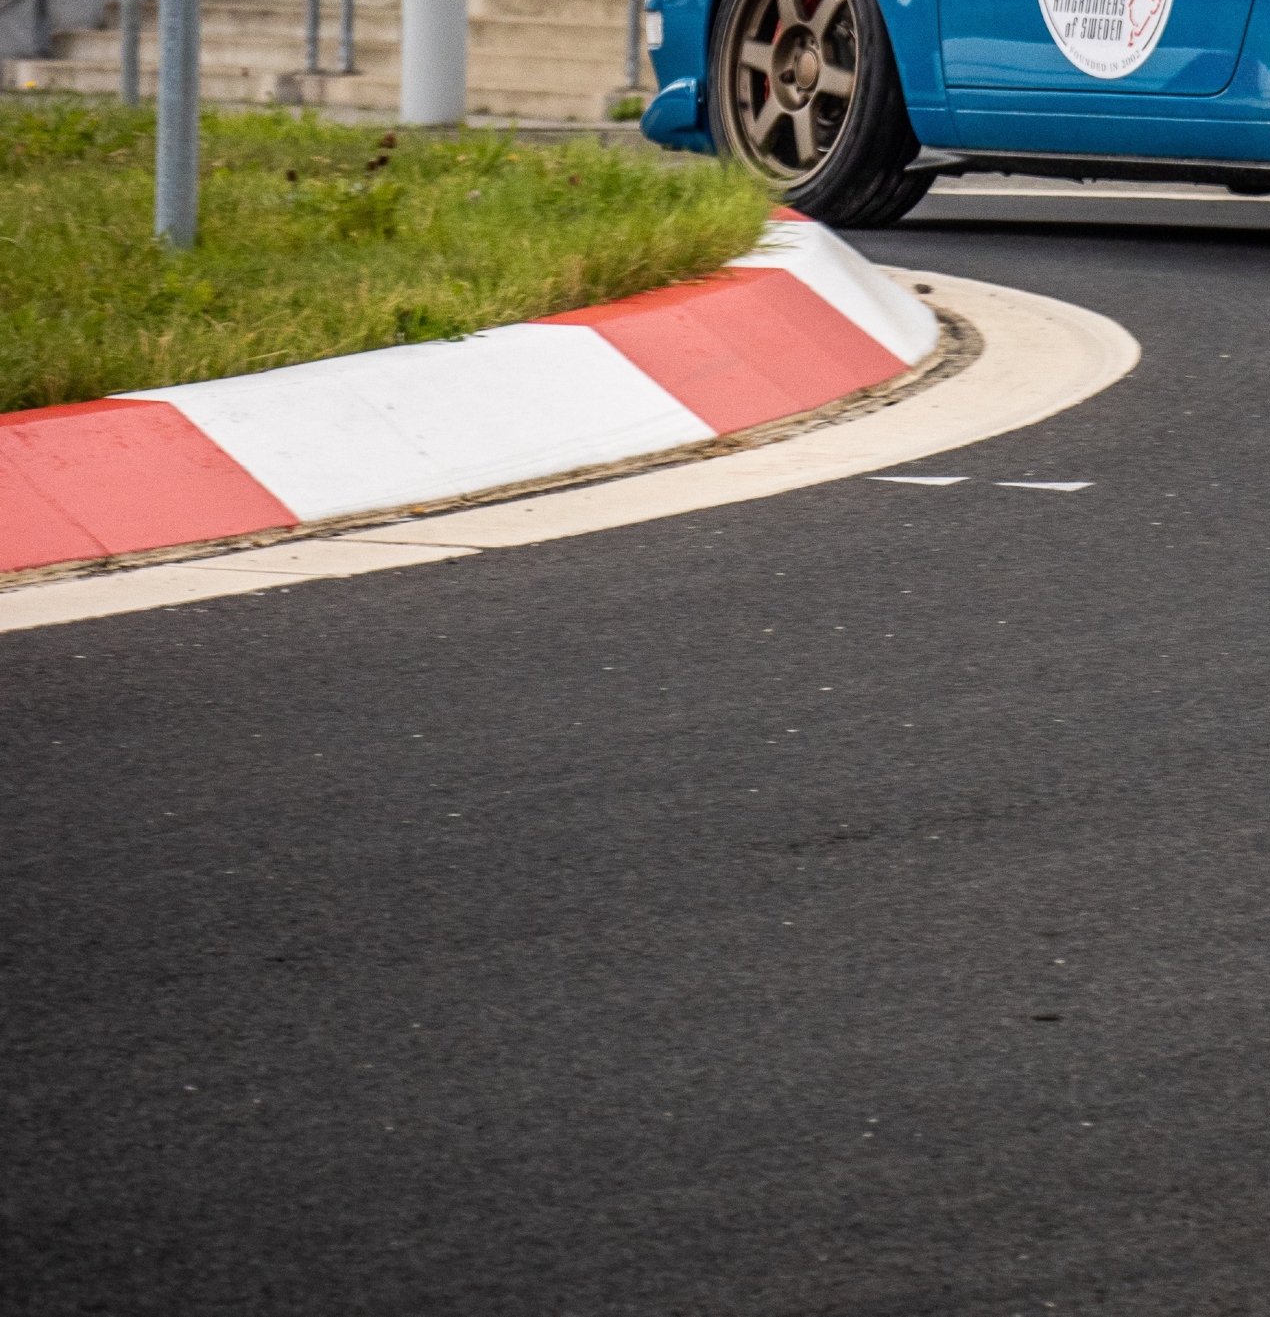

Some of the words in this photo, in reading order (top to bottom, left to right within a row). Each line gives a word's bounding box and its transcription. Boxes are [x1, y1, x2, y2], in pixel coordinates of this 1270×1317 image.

[1065, 17, 1079, 38] of
[1080, 17, 1123, 41] SWEDEN
[1069, 46, 1106, 72] FOUNDED
[1110, 62, 1118, 72] IN
[1121, 50, 1140, 69] 2002
